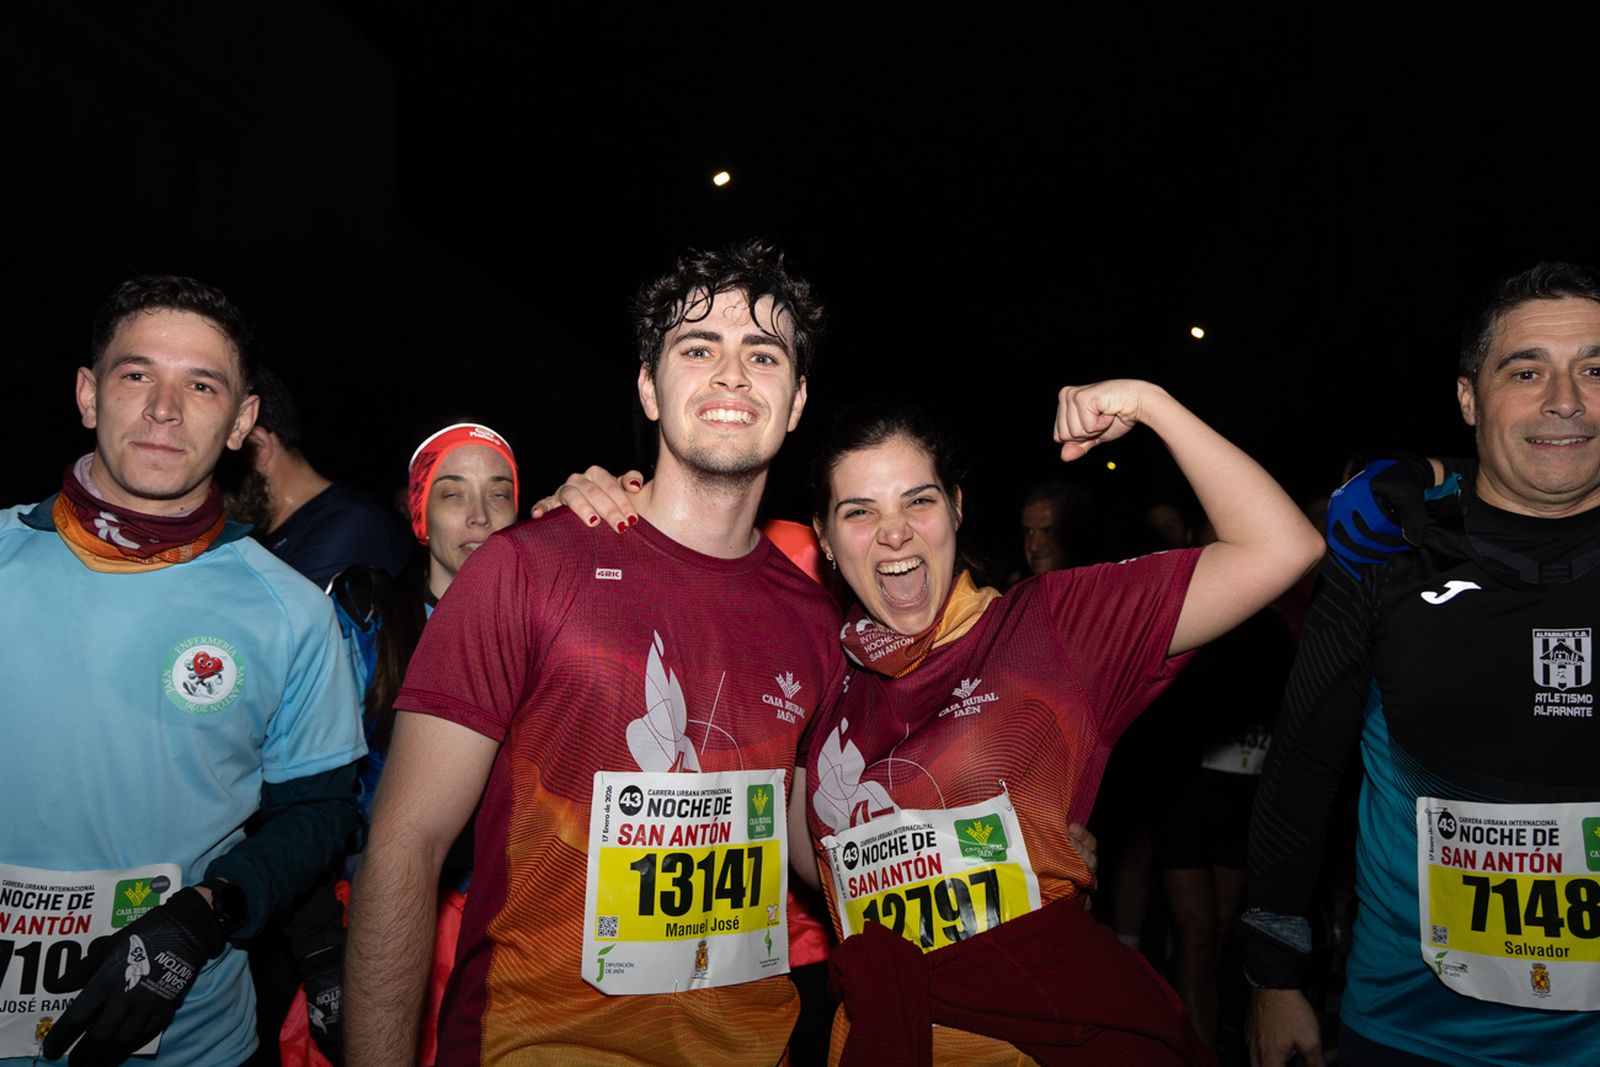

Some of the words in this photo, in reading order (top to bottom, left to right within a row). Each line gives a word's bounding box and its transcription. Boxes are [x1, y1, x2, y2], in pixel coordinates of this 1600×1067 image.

[869, 649, 886, 662] SAN
[962, 692, 999, 707] RURAL
[1535, 692, 1594, 704] ATLETISMO
[1533, 705, 1593, 717] ALFARNATE
[620, 792, 642, 808] 43
[647, 789, 676, 797] CARRERA
[676, 789, 700, 797] URBANA
[646, 798, 712, 818] NOCHE
[713, 796, 733, 816] DE
[1439, 817, 1456, 833] 43
[1459, 816, 1483, 826] CARRERA
[1483, 819, 1508, 827] URBANA
[617, 823, 666, 847] SAN
[668, 816, 732, 847] ANTÓN
[1460, 824, 1527, 847] NOCHE
[1532, 828, 1559, 847] DE
[844, 846, 858, 863] 43
[861, 835, 909, 867] NOCHE
[911, 831, 938, 852] DE
[1441, 845, 1477, 870] SAN
[1482, 847, 1563, 873] ANTÓN
[630, 846, 763, 917] 13147
[848, 870, 880, 899] SAN
[881, 850, 943, 890] ANTÓN
[2, 880, 24, 889] CARRERA
[24, 883, 48, 891] URBANA
[0, 887, 65, 911] NOCHE
[67, 892, 96, 911] DE
[1463, 874, 1600, 940] 7148
[11, 911, 92, 936] ANTÓN
[666, 920, 708, 937] Manuel
[711, 915, 740, 932] José
[1504, 941, 1570, 958] Salvador
[161, 972, 187, 990] SAN
[0, 997, 37, 1014] JOSÉ
[40, 997, 75, 1012] RAM
